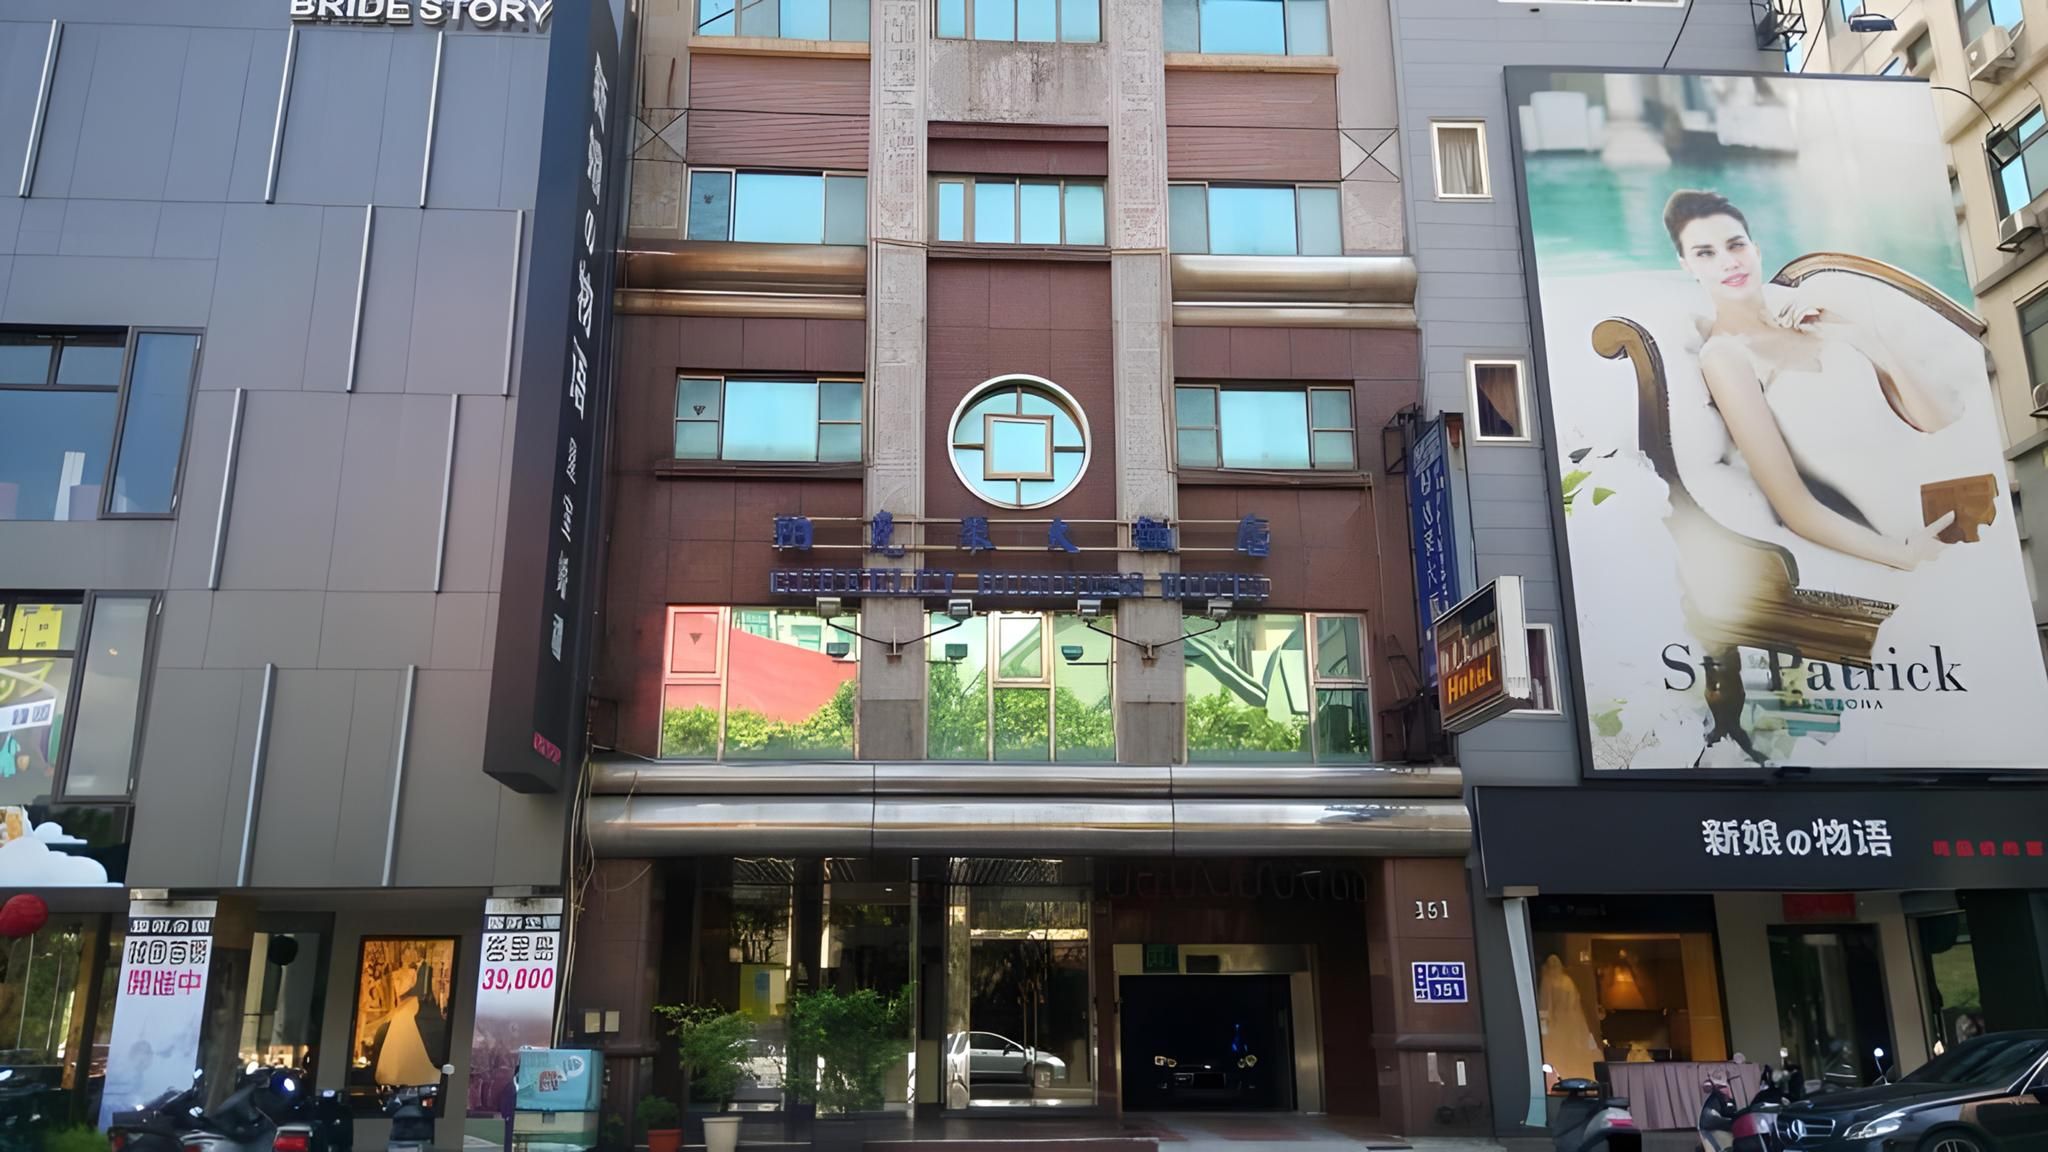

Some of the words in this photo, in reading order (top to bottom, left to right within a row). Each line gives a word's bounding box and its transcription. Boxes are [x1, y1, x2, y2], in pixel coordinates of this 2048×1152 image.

[290, 0, 413, 24] BRIDE
[1702, 818, 1893, 857] 新娘の物语
[482, 967, 554, 994] 39,000
